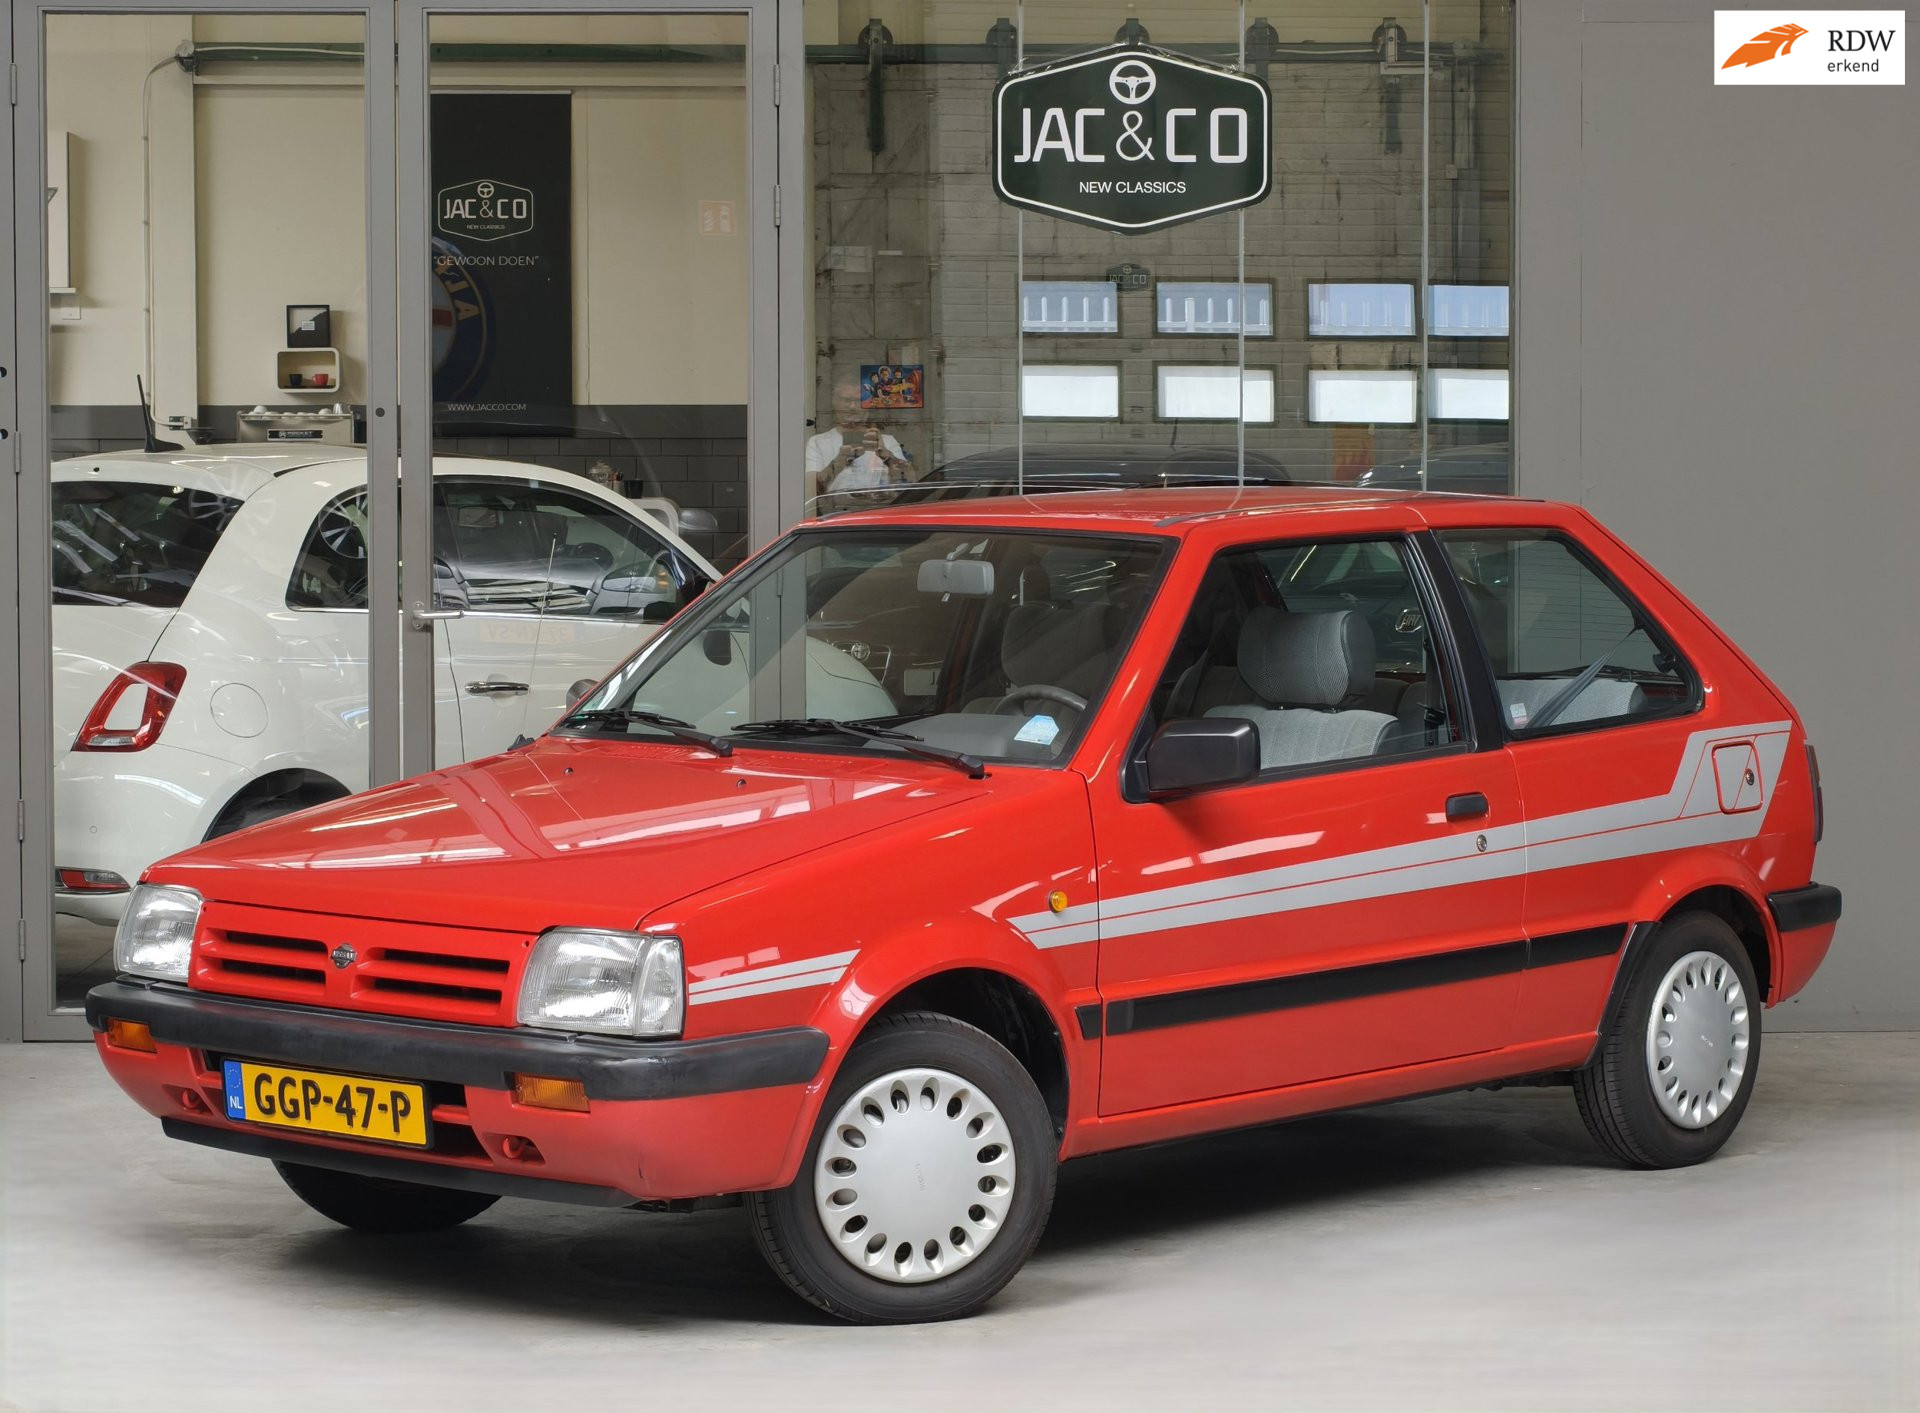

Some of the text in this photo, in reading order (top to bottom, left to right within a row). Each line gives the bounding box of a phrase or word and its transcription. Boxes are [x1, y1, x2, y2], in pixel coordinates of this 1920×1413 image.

[1079, 181, 1187, 193] NEW CLASSICS
[447, 403, 527, 411] WWW.JACCO.COM
[229, 1095, 243, 1110] NL
[254, 1072, 412, 1133] GGP-47-P
